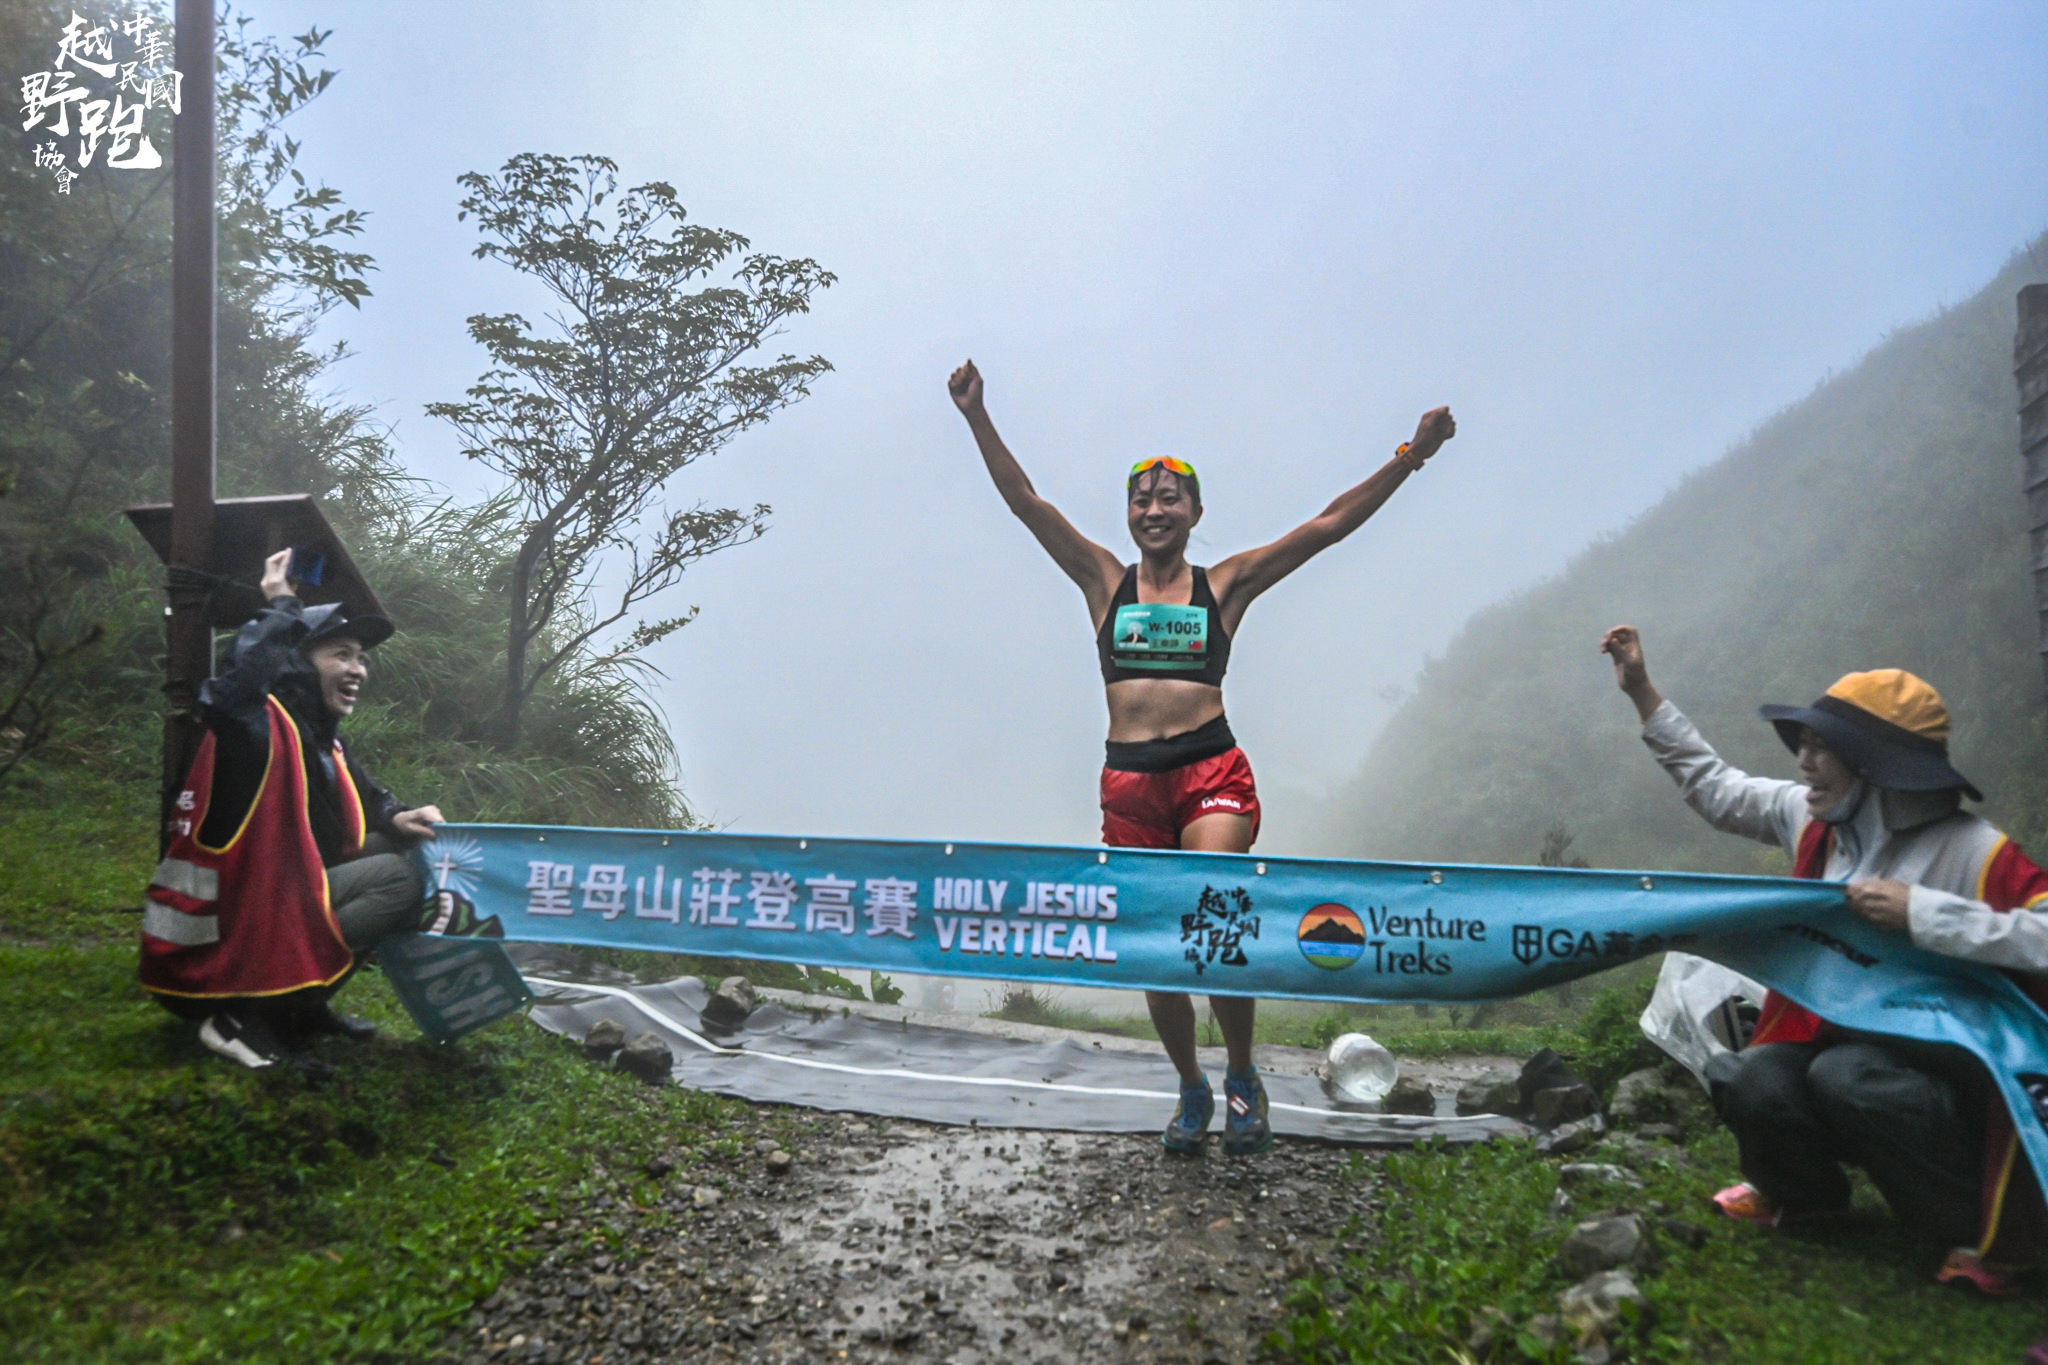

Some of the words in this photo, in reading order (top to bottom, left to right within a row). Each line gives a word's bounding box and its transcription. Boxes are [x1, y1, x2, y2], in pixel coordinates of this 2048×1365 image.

[1148, 621, 1202, 635] W-1005
[526, 859, 918, 940] 聖母山莊登高賽
[933, 877, 1009, 914] HOLY
[1018, 881, 1118, 922] JESUS
[933, 916, 1118, 965] VERTICAL
[1368, 905, 1487, 943] Venture
[1368, 940, 1453, 976] Treks
